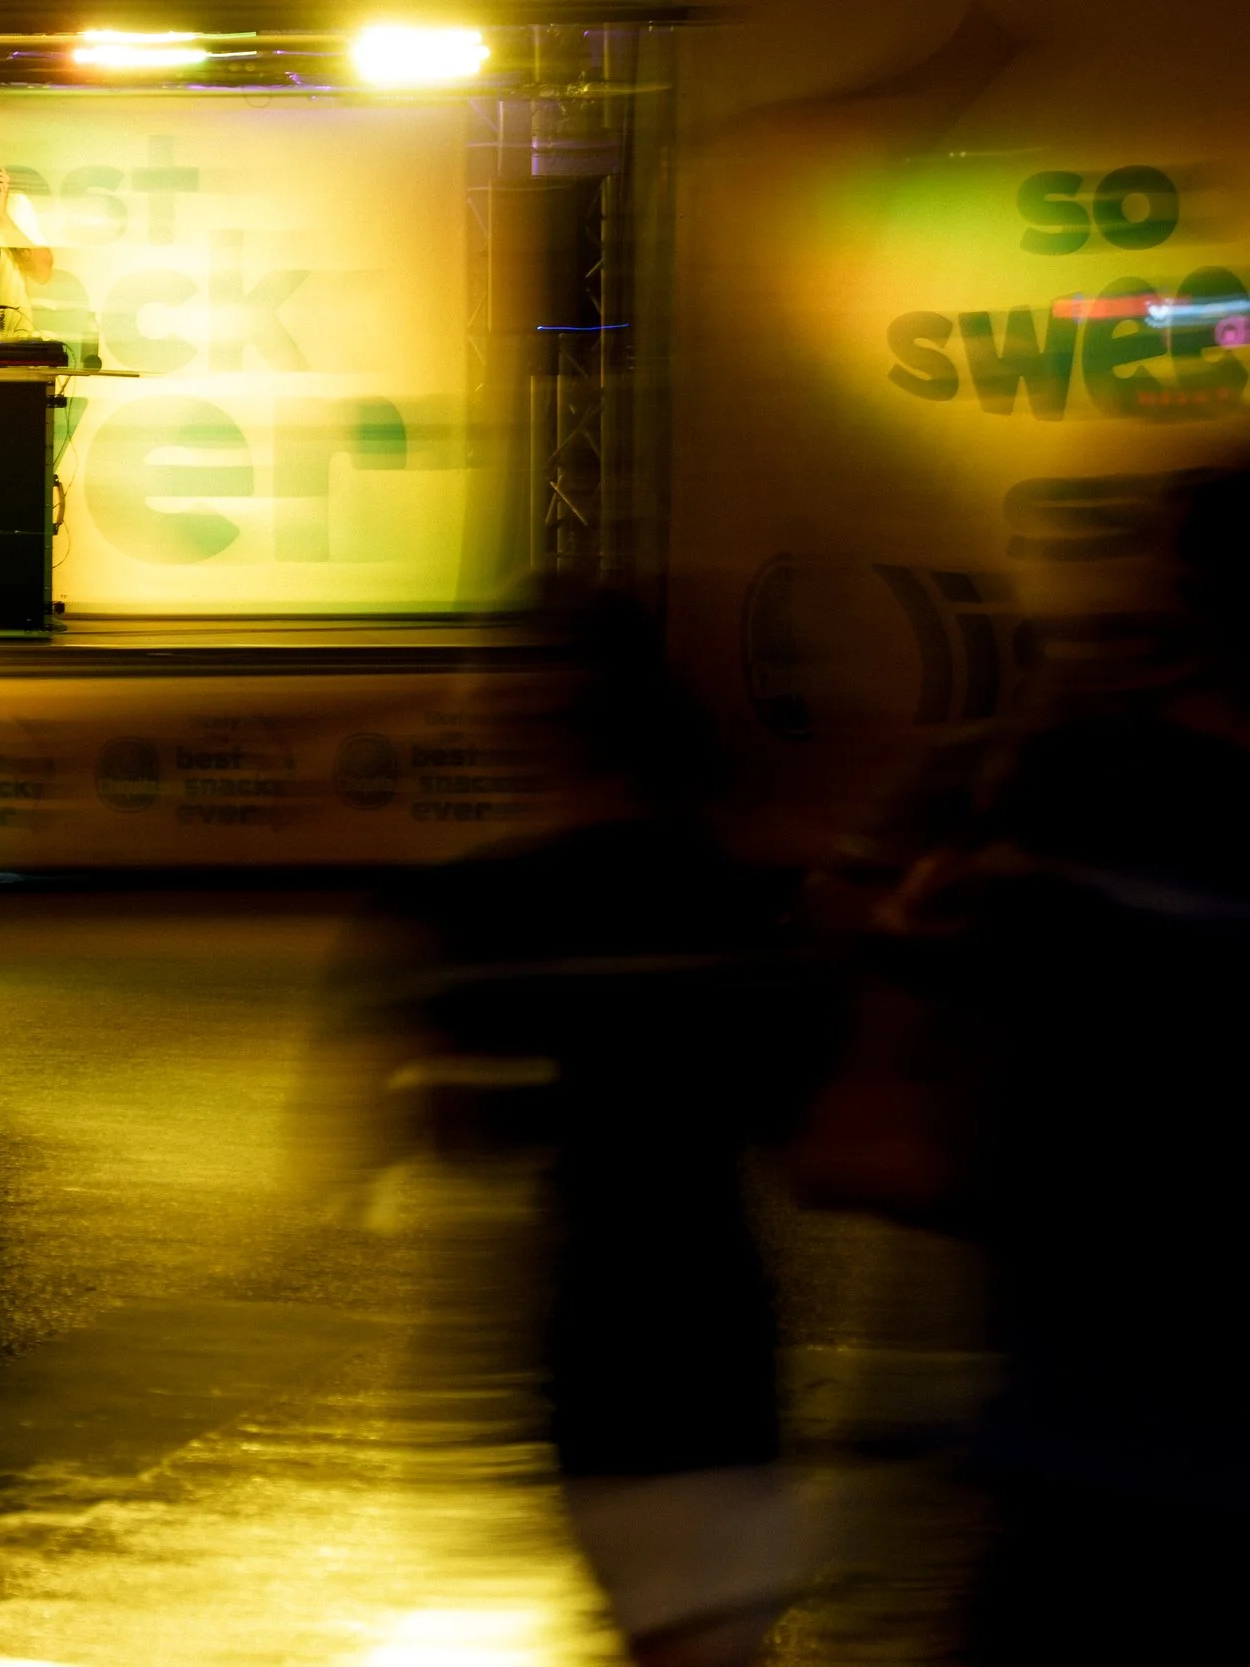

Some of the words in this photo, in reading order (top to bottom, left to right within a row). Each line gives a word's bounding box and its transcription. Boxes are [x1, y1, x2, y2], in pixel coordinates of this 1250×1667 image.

[1015, 164, 1180, 257] so
[175, 744, 244, 770] best
[410, 801, 493, 823] ever
